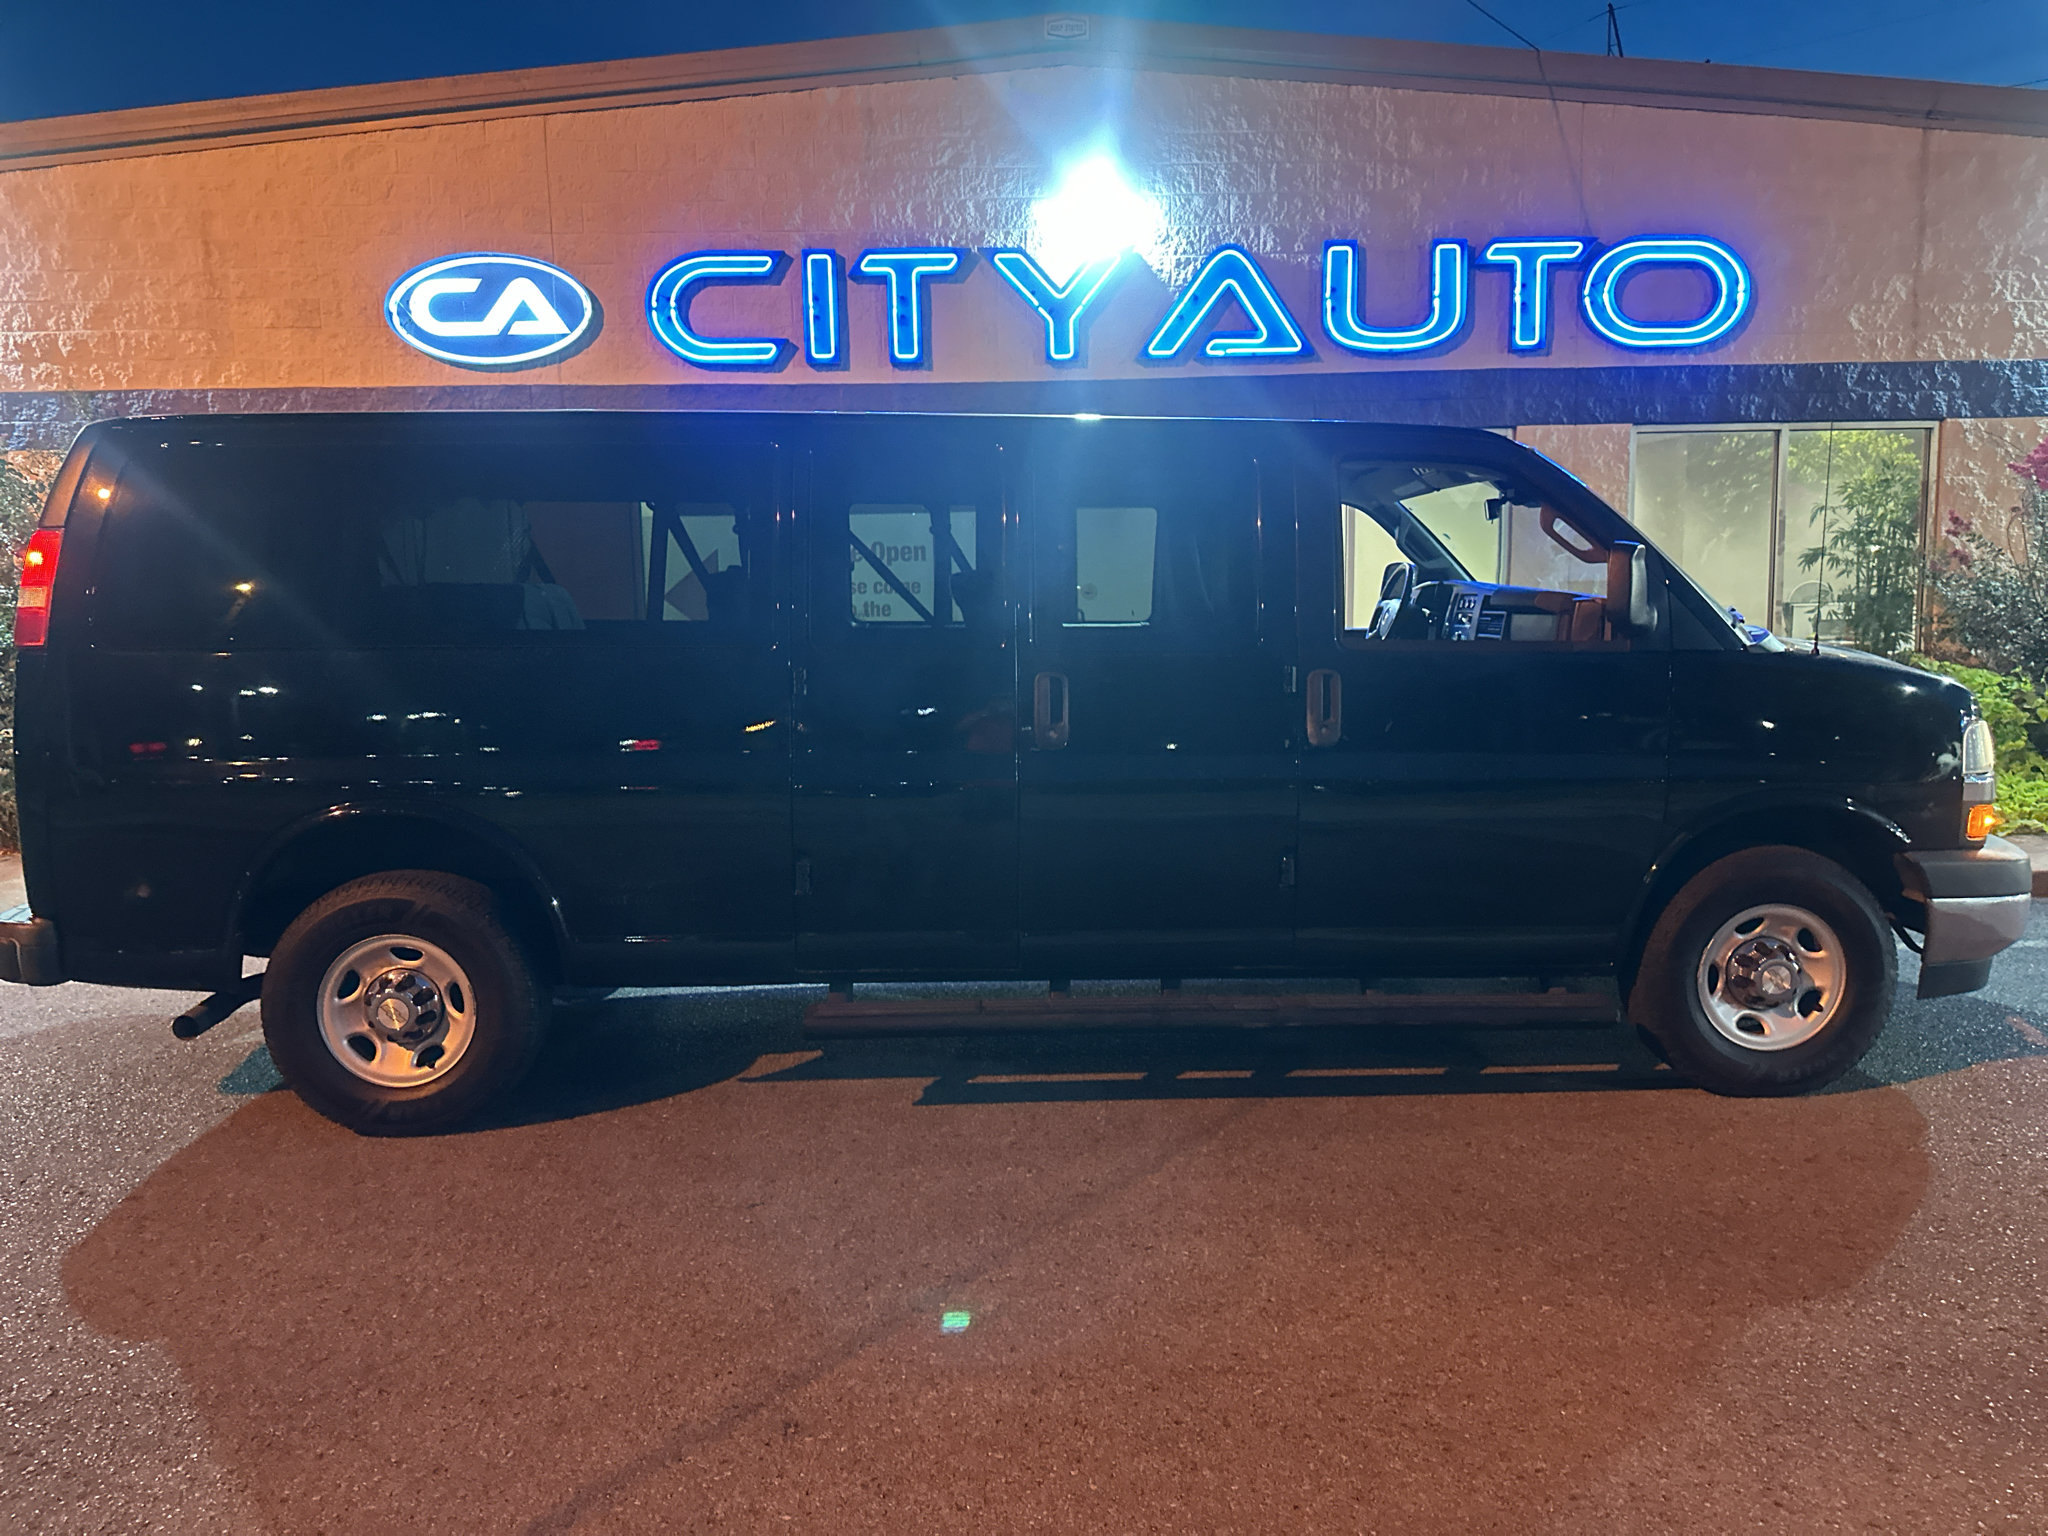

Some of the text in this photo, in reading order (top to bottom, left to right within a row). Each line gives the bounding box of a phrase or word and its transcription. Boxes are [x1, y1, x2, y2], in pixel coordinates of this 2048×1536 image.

[409, 276, 572, 337] CA
[646, 234, 1752, 369] CITY AUTO
[871, 541, 927, 566] Open
[873, 581, 921, 594] coe
[863, 601, 892, 617] the
